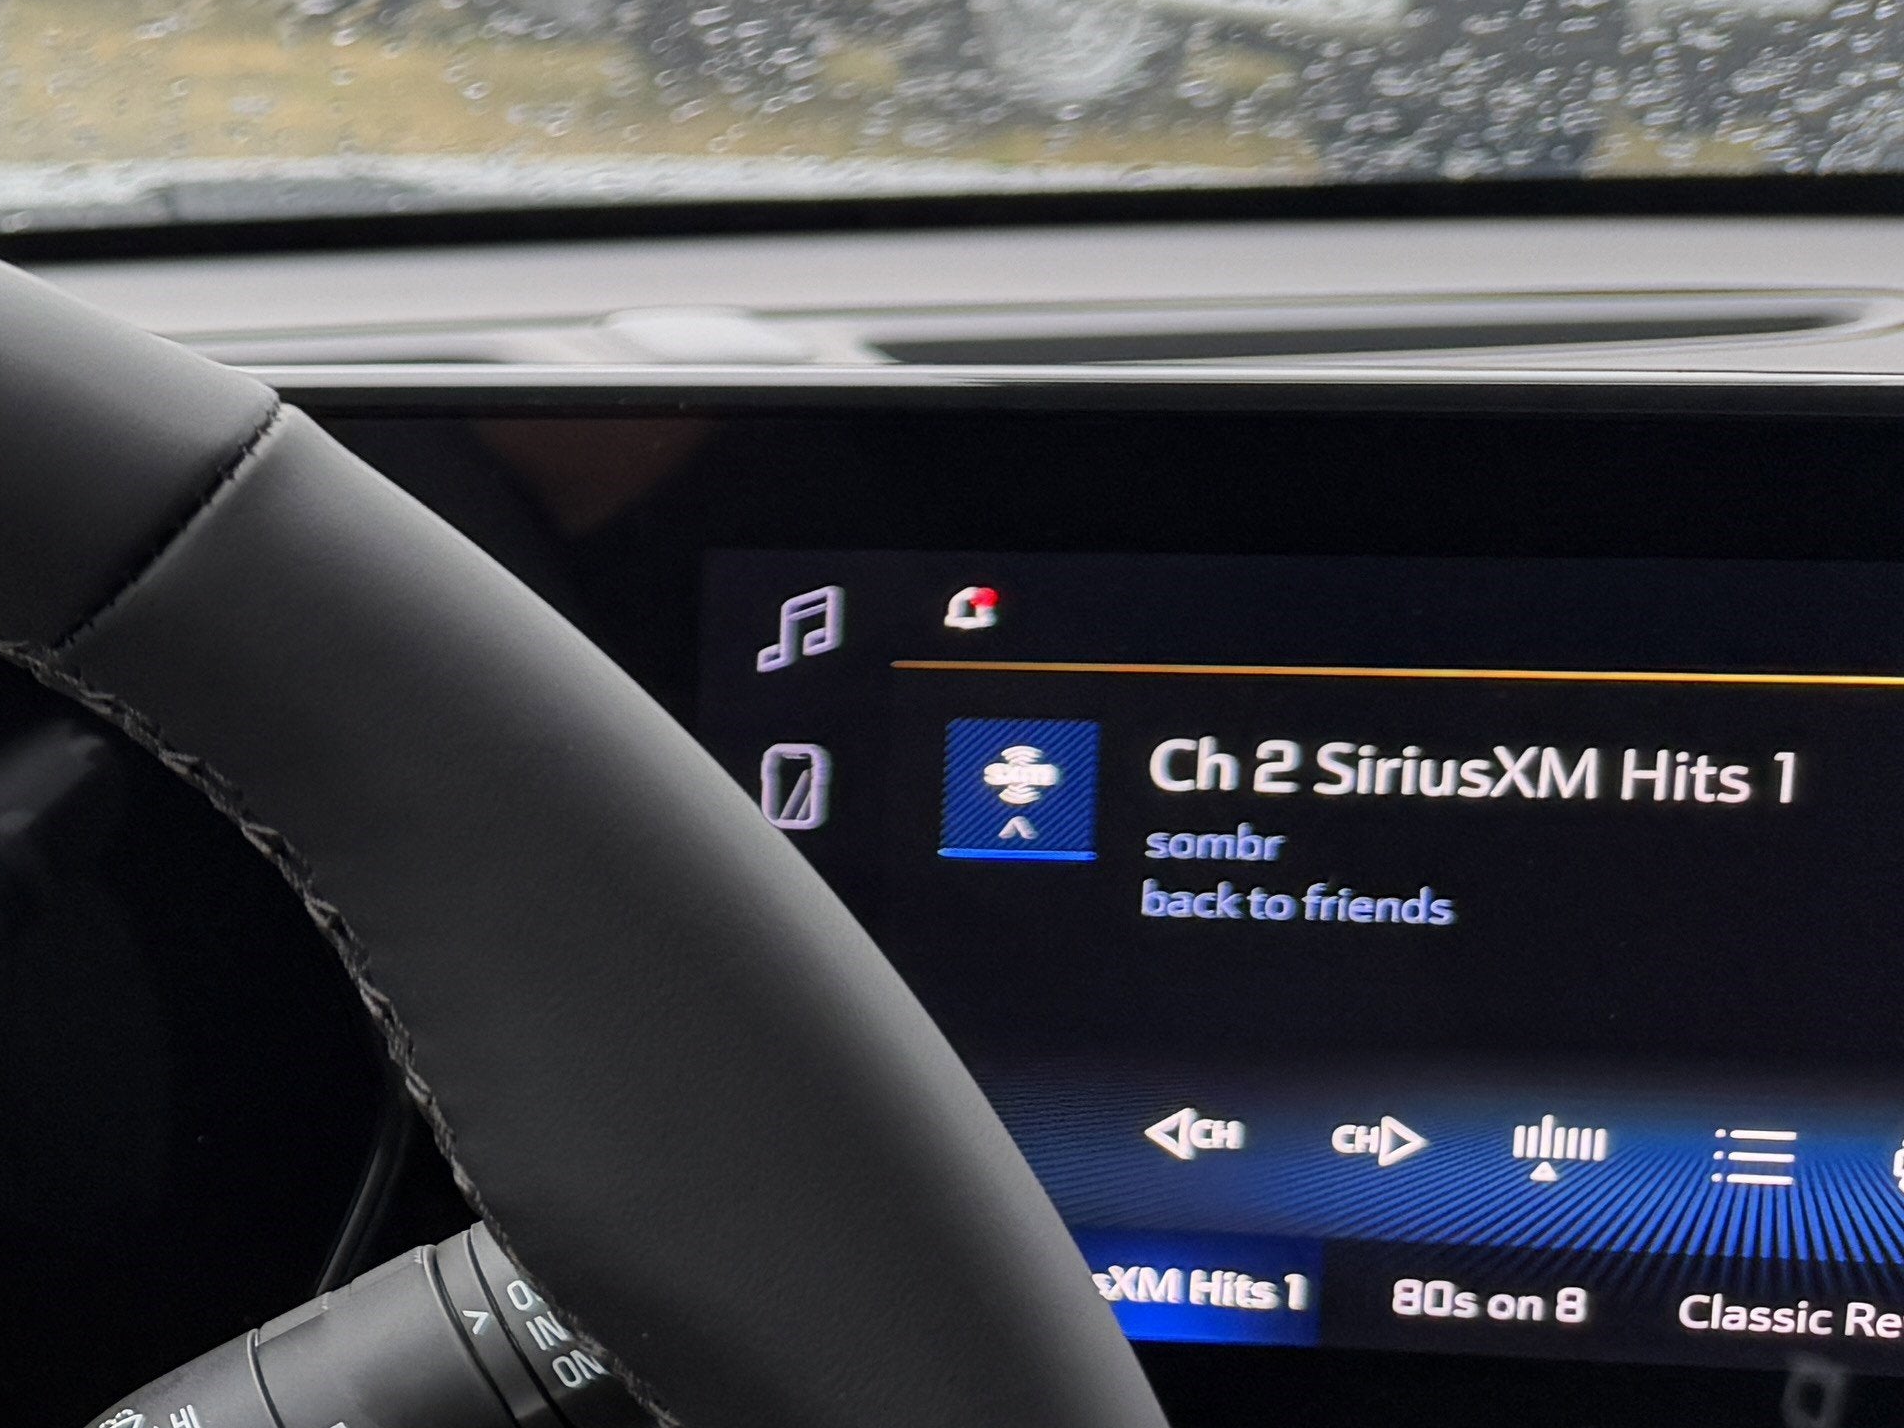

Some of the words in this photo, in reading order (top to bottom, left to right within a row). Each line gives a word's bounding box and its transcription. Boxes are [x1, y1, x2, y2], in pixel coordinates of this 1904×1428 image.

[1148, 736, 1238, 792] Ch
[1253, 739, 1300, 794] 2
[1313, 741, 1599, 801] SiriusXM
[1620, 748, 1751, 804] Hits
[1773, 751, 1796, 804] 1
[1144, 822, 1286, 862] sombr
[1141, 878, 1242, 922] back
[1245, 882, 1297, 923] to
[1301, 882, 1455, 926] friends
[1193, 1118, 1244, 1149] CH
[1331, 1124, 1379, 1154] CH
[1189, 1269, 1279, 1310] Hits
[1283, 1272, 1311, 1311] 1
[1392, 1278, 1480, 1320] 80s
[1486, 1292, 1542, 1322] on
[1554, 1286, 1588, 1324] 8
[526, 1310, 570, 1351] IN
[1678, 1292, 1834, 1337] Classic
[1844, 1301, 1904, 1340] Re
